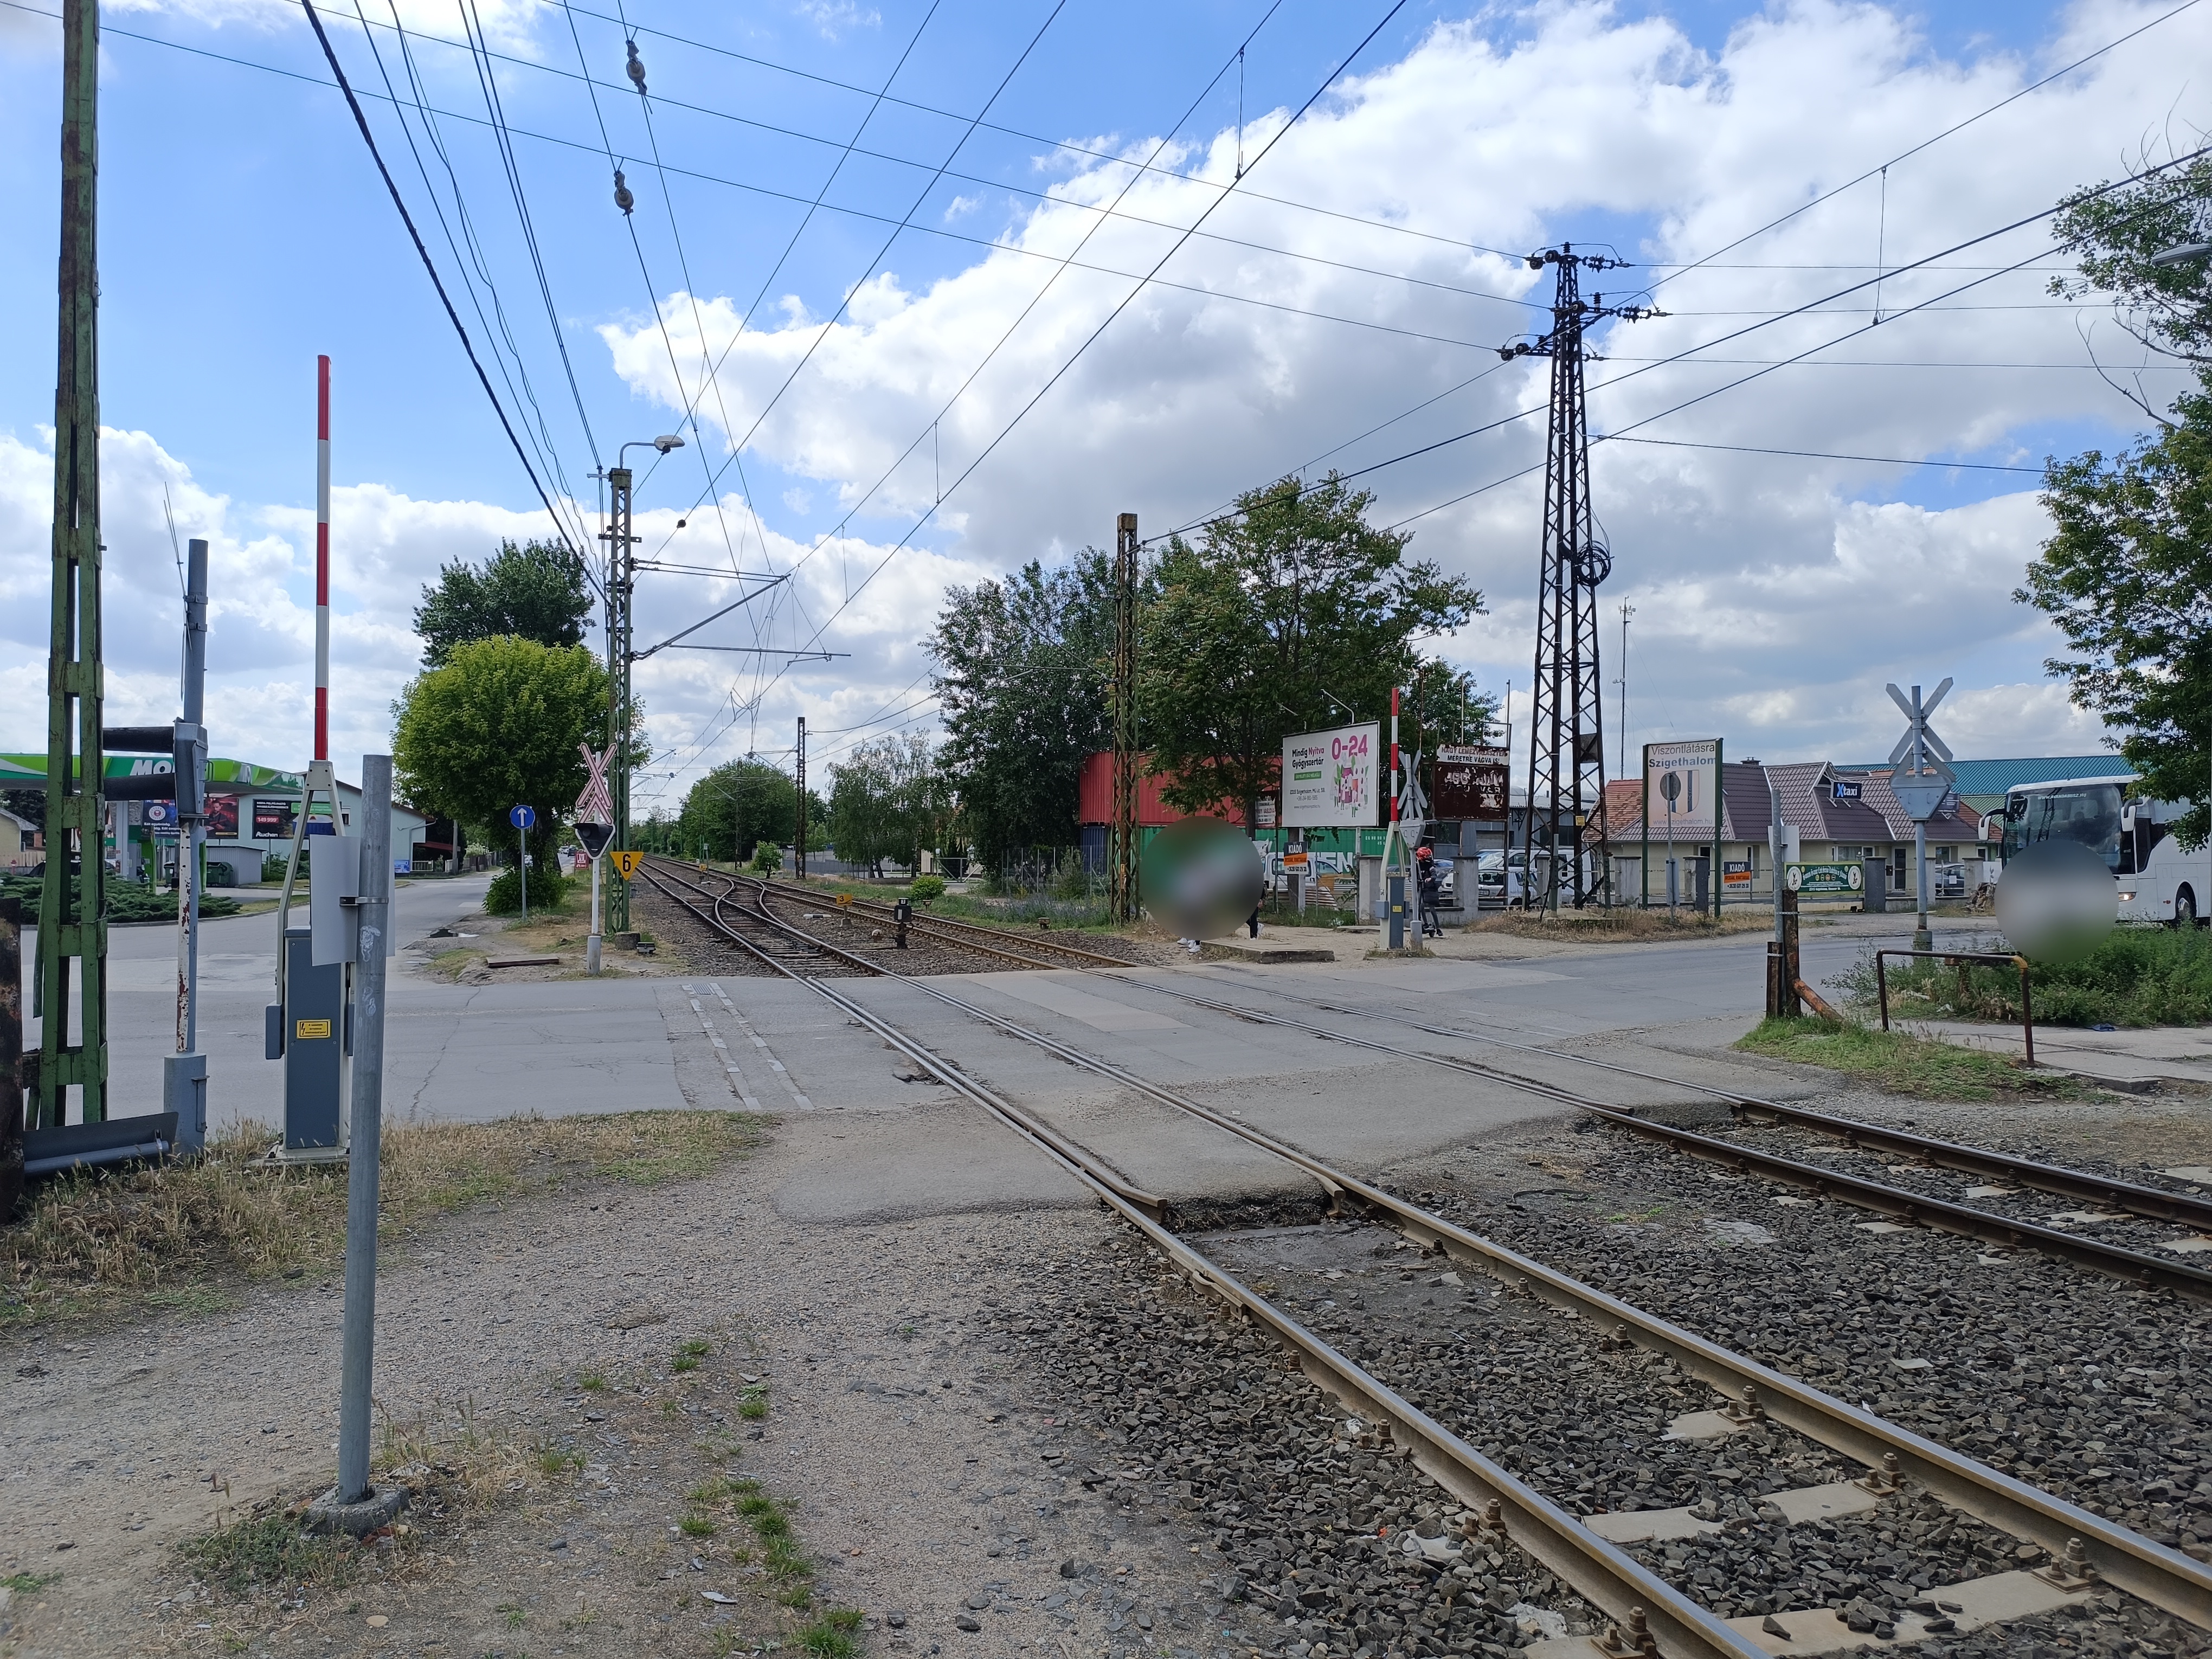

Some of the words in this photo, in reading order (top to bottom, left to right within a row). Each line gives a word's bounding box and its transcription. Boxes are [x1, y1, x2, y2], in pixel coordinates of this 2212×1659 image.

[1292, 748, 1308, 758] Mindig
[1308, 747, 1324, 757] Nyitva
[1332, 734, 1368, 760] 0-24
[1651, 743, 1715, 755] Viszontlátásra
[130, 760, 175, 776] MO
[1292, 757, 1324, 769] Gyógyszertár
[1649, 756, 1715, 769] Szigethalom
[1836, 783, 1857, 797] Xtaxi
[1653, 818, 1713, 826] wwwzigethalom.hu
[1288, 843, 1302, 854] KIADÓ
[622, 853, 631, 872] 6
[1729, 862, 1745, 872] KIADÓ
